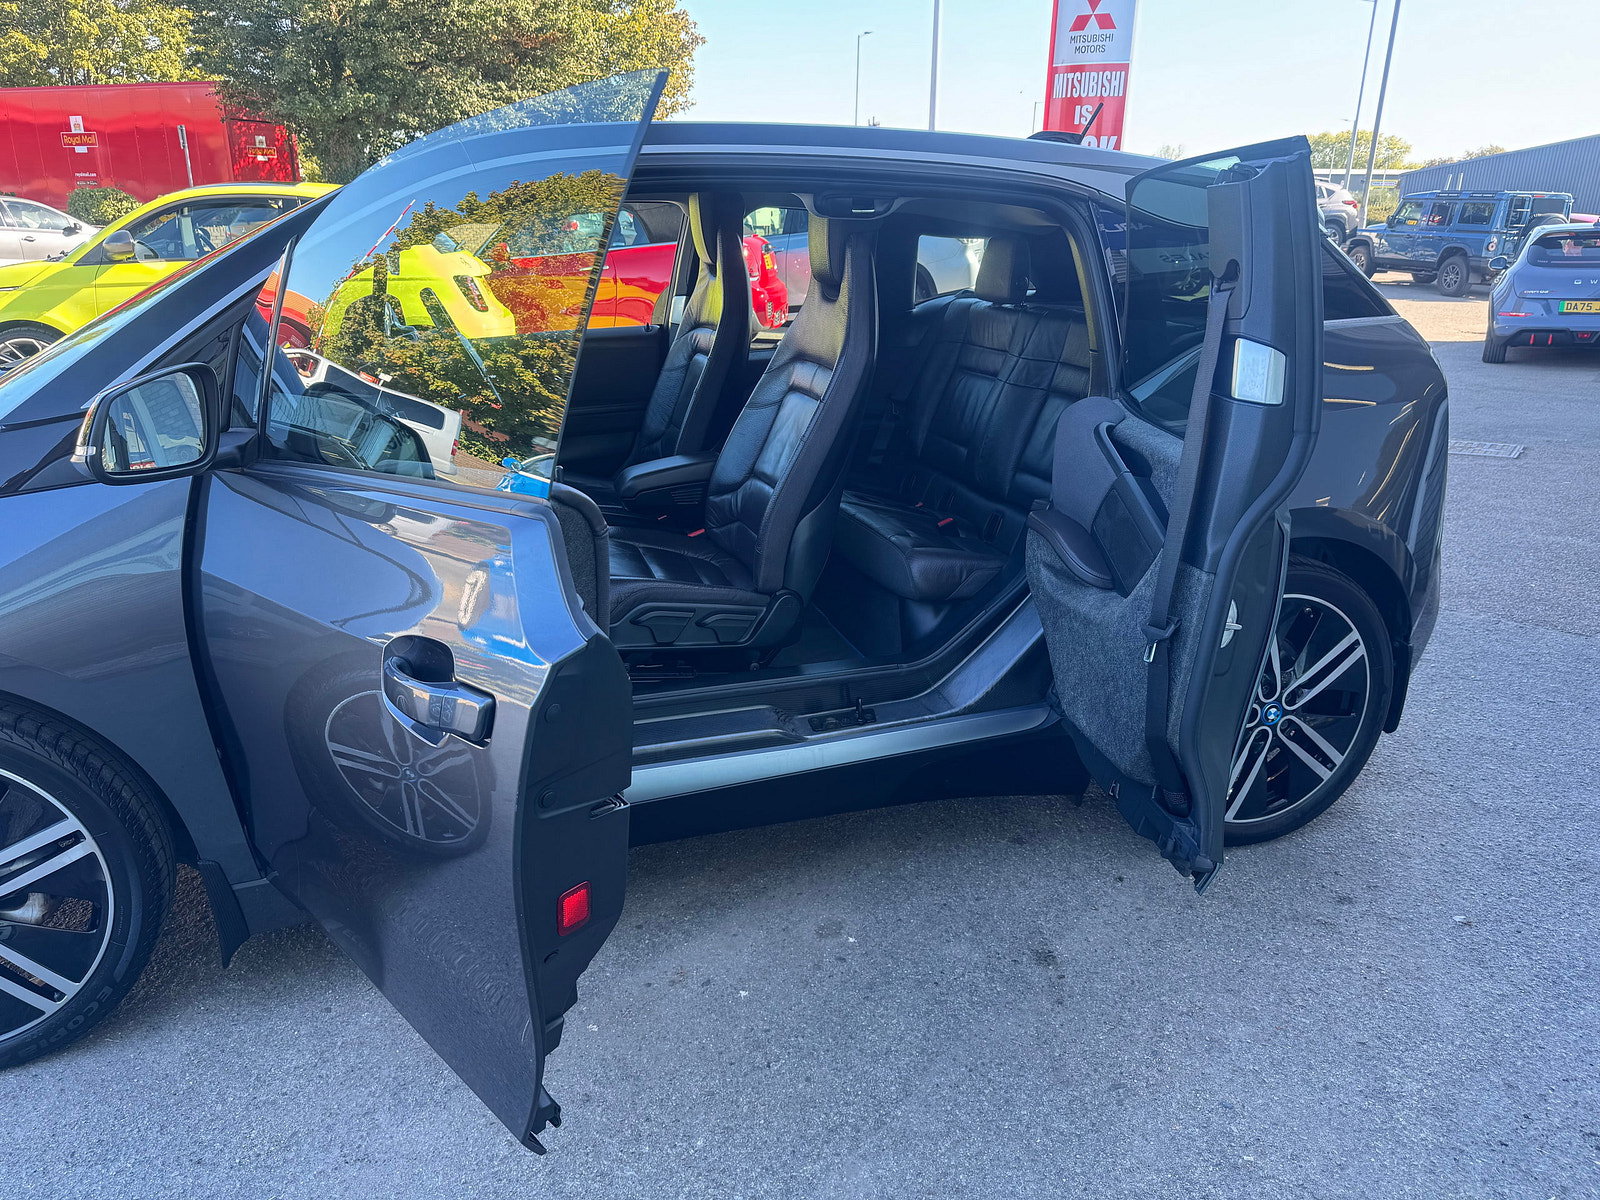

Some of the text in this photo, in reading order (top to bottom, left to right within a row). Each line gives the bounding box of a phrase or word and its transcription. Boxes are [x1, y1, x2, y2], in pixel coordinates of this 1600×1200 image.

[1069, 33, 1114, 44] MITSUBISHI
[1074, 44, 1106, 54] MOTORS
[1053, 70, 1126, 99] MITSUBISHI
[1073, 104, 1093, 125] IS
[63, 134, 96, 146] Royal Mail
[1565, 302, 1593, 311] DA75
